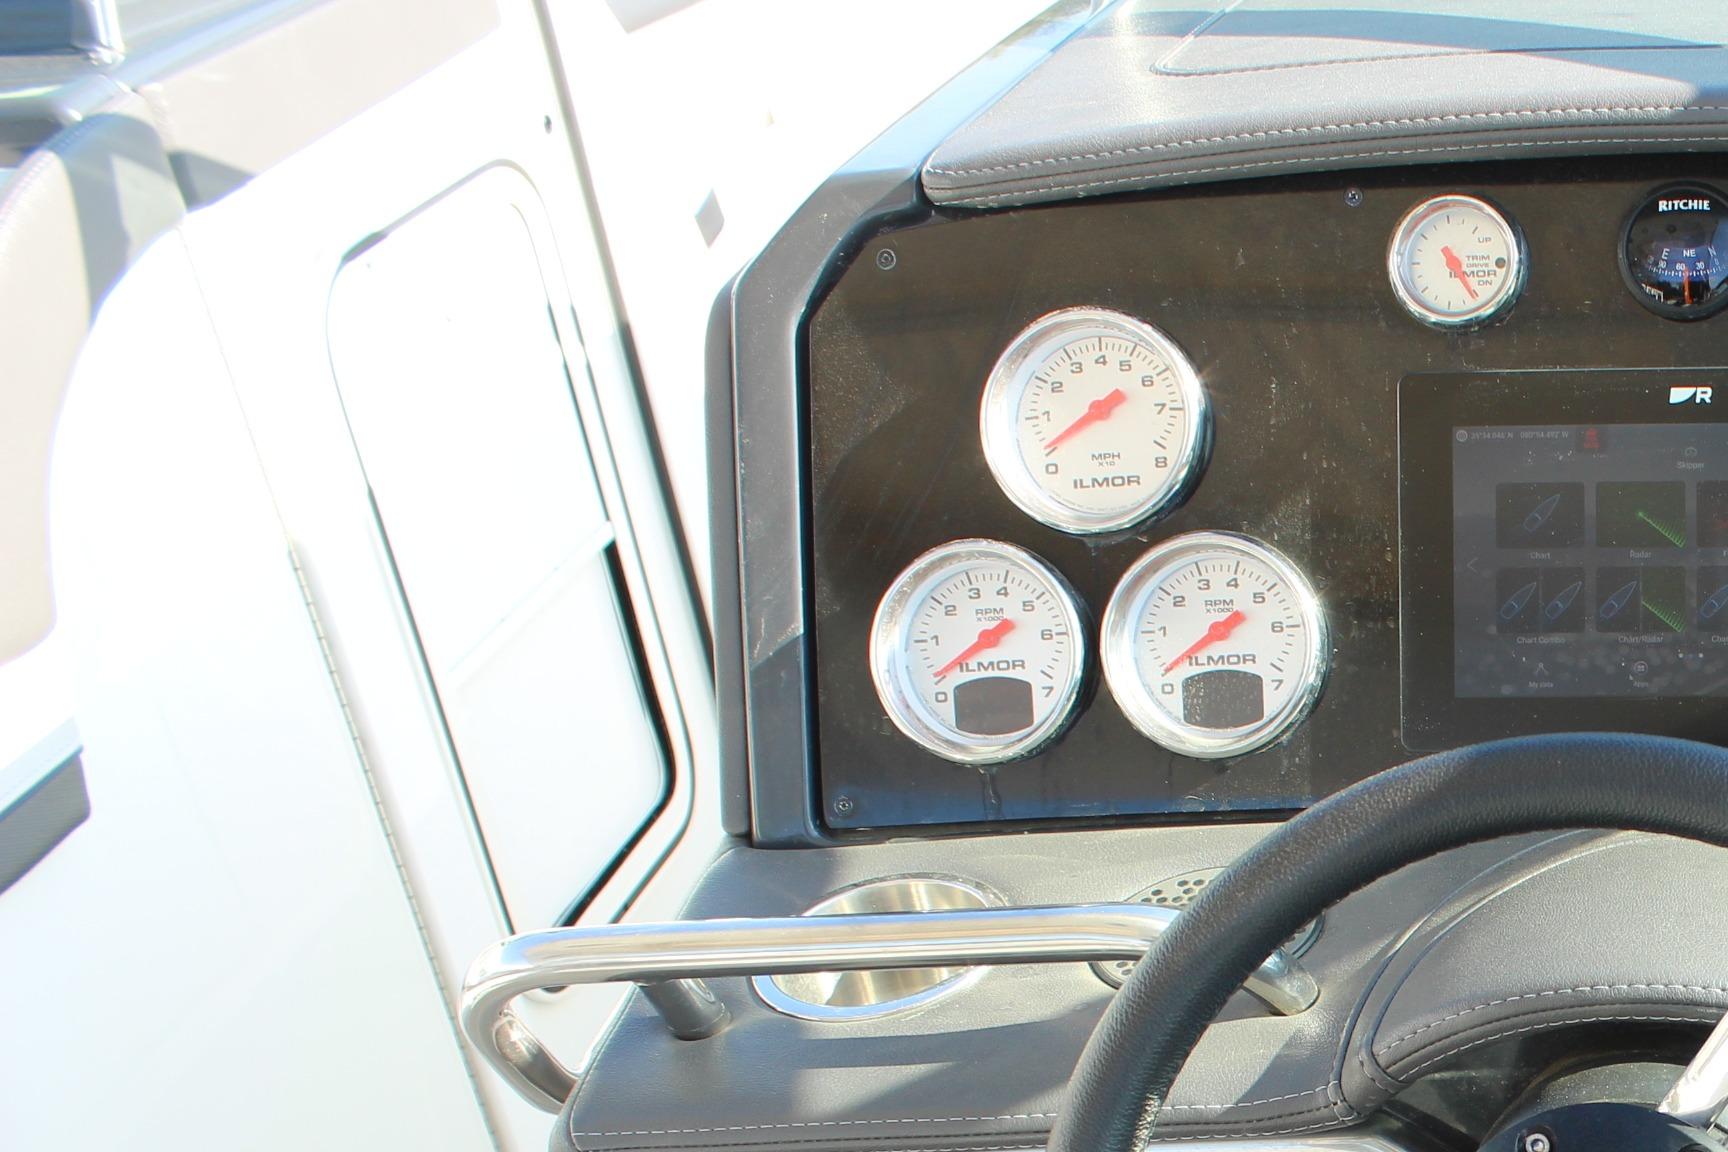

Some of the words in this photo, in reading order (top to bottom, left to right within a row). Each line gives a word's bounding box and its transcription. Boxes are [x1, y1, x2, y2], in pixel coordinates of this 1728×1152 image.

[1658, 200, 1710, 212] RITCHIE
[1662, 248, 1669, 259] E
[1095, 355, 1107, 366] 4
[1119, 360, 1132, 371] 5
[1071, 362, 1083, 373] 3
[1142, 376, 1154, 387] 6
[1051, 382, 1064, 393] 2
[1154, 404, 1166, 414] 7
[1043, 411, 1051, 421] 1
[1091, 452, 1120, 461] MPH
[1155, 457, 1168, 468] 8
[1045, 464, 1058, 475] 0
[1073, 475, 1141, 489] ILMOR
[1530, 552, 1550, 560] Chart
[1198, 578, 1210, 591] 3
[1225, 578, 1239, 589] 4
[968, 588, 980, 599] 3
[996, 587, 1009, 598] 4
[1252, 592, 1265, 604] 5
[1022, 601, 1034, 612] 5
[1173, 595, 1186, 607] 2
[1204, 598, 1234, 608] RPM
[945, 605, 957, 616] 2
[975, 607, 1004, 617] RPM
[1157, 625, 1166, 636] 1
[1271, 621, 1284, 633] 6
[1041, 629, 1053, 640] 6
[1517, 636, 1536, 644] Chart
[1618, 635, 1663, 644] Chart/Radar
[930, 635, 939, 646] 1
[1187, 653, 1256, 667] ILMOR
[958, 659, 1025, 673] ILMOR
[1161, 683, 1174, 694] 0
[1272, 679, 1284, 690] 7
[935, 691, 947, 703] 0
[1042, 686, 1054, 697] 7
